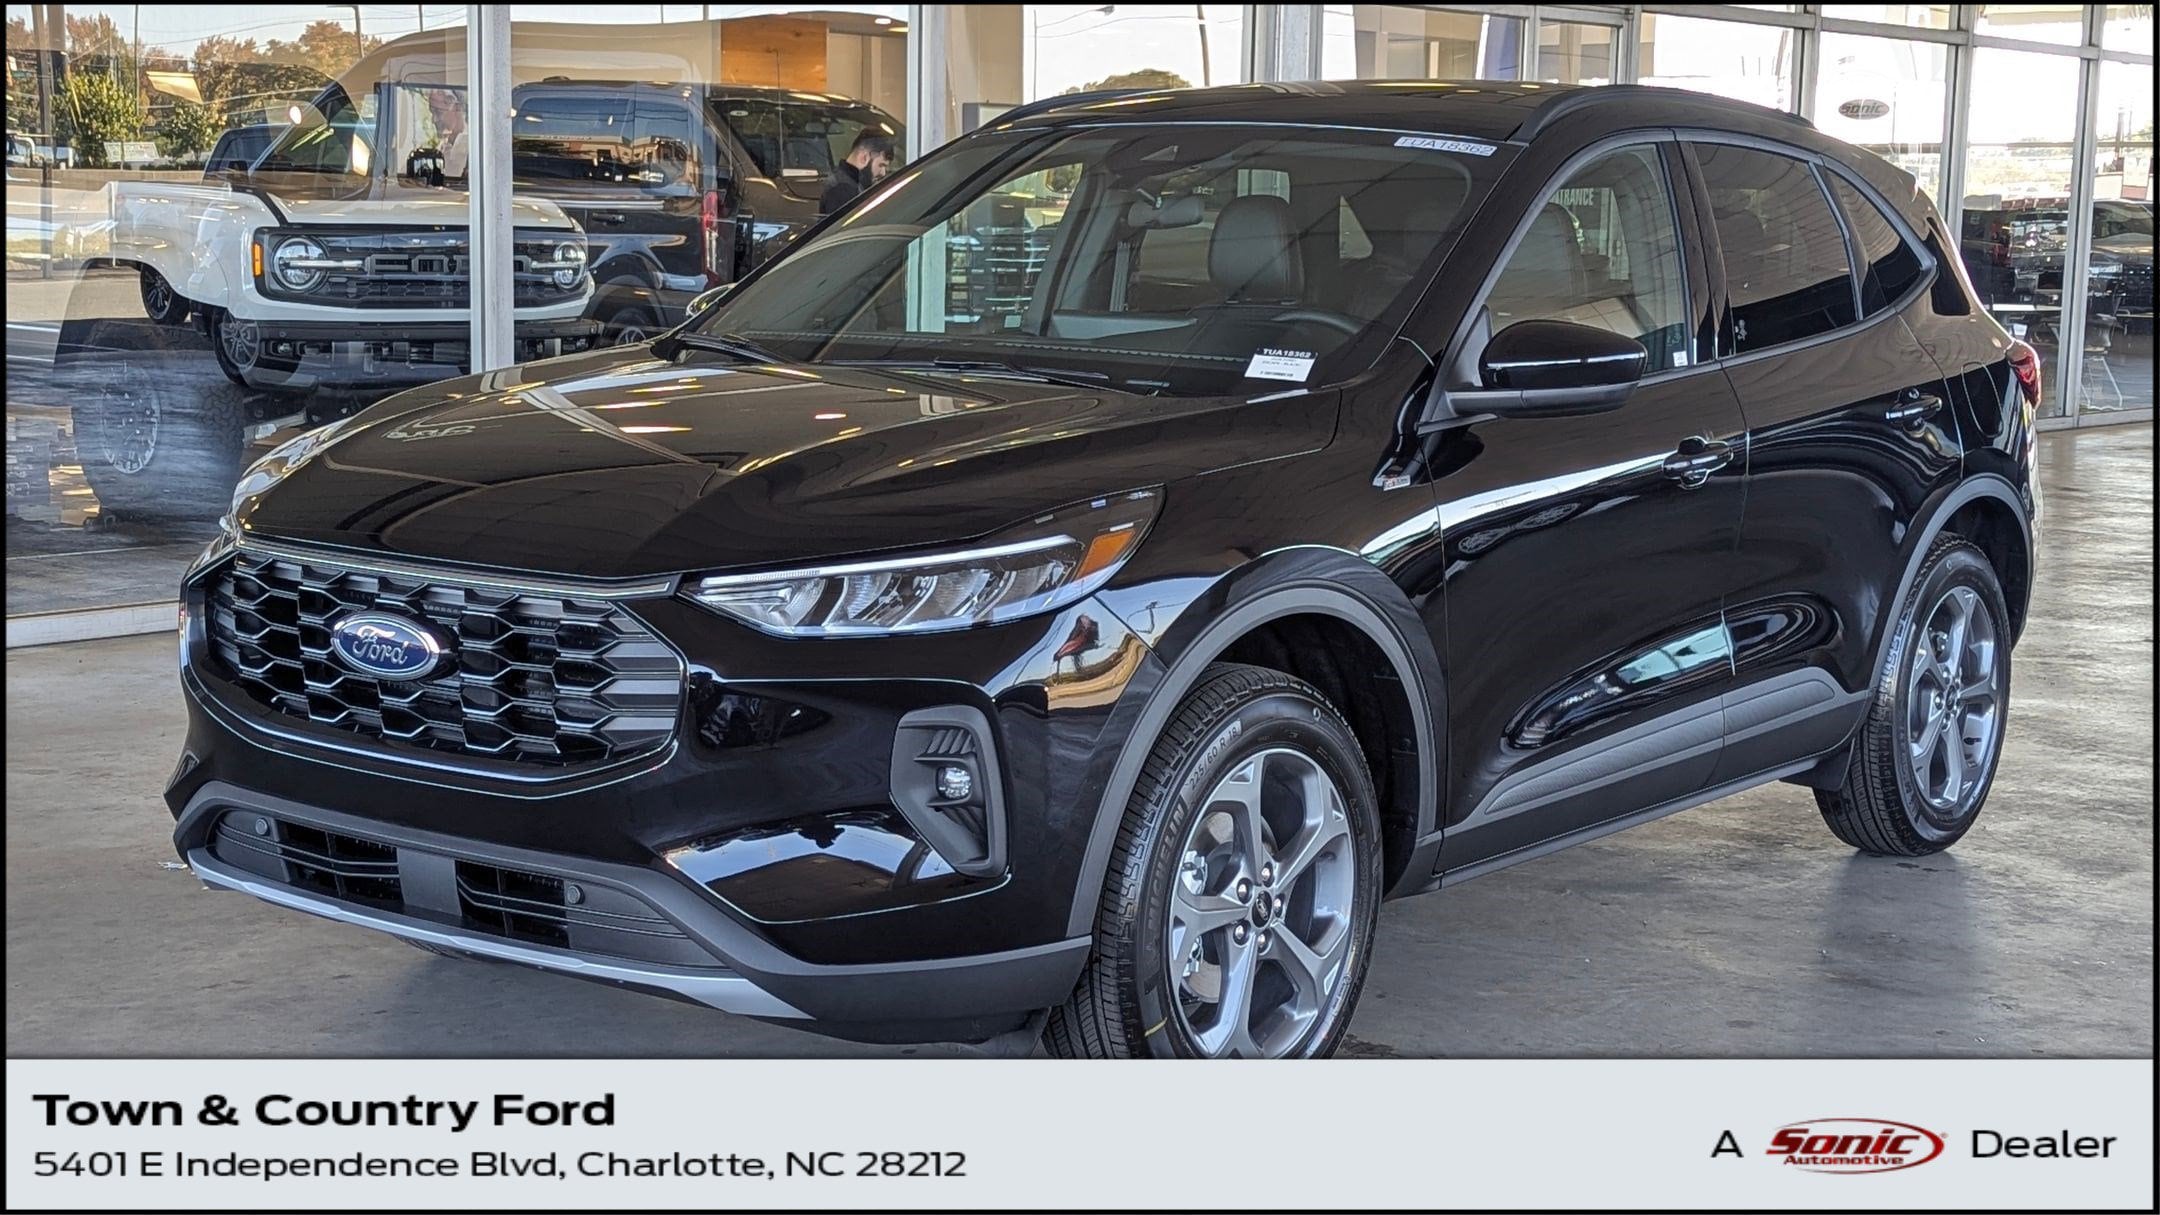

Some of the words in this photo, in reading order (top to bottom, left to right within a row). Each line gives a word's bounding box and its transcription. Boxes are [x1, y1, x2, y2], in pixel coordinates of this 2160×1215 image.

[1400, 137, 1494, 156] TUA18362
[1263, 348, 1312, 358] TUA18362
[352, 625, 408, 664] Ford
[1189, 745, 1218, 791] 225/60
[1148, 803, 1186, 931] MICHELIN
